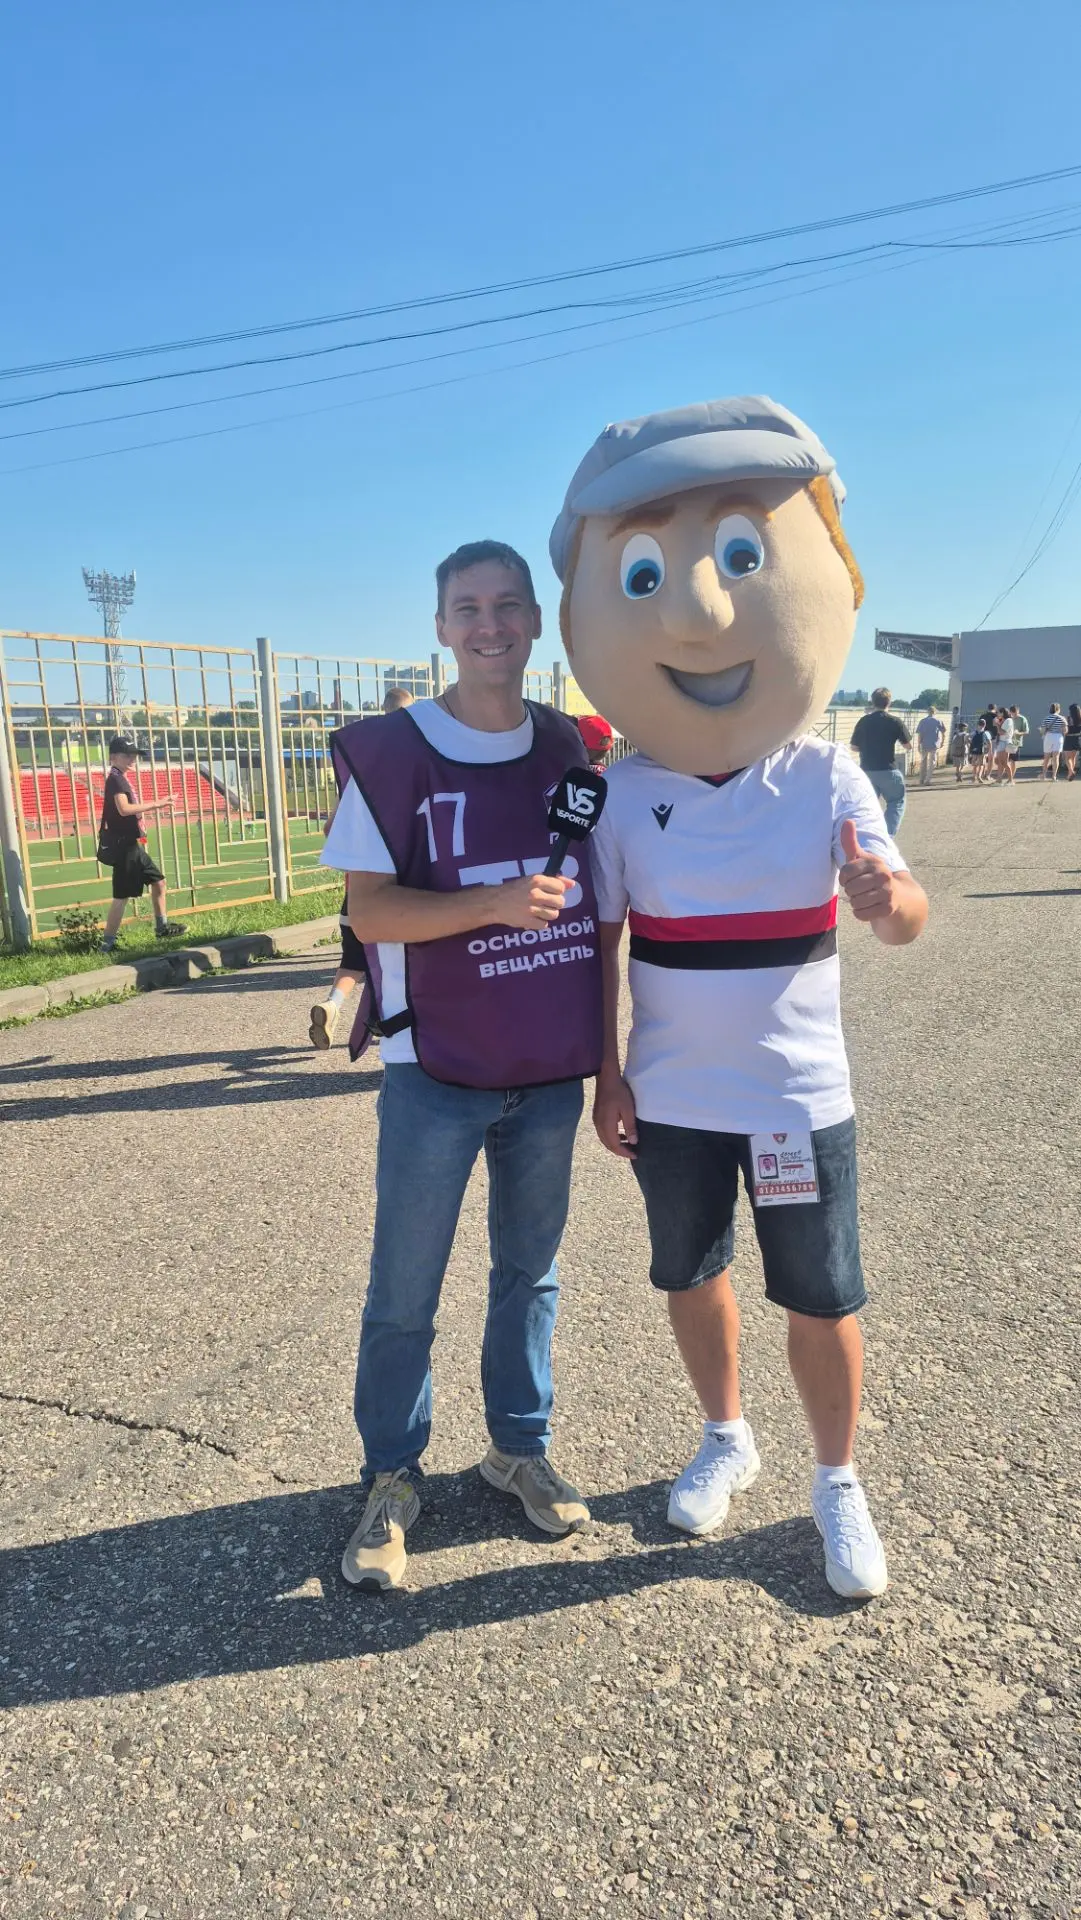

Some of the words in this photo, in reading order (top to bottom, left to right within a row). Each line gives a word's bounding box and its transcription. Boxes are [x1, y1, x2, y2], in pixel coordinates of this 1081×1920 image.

[416, 791, 466, 863] 17
[467, 916, 595, 955] ОСНОВНОЙ
[479, 945, 595, 979] ВЕЩАТЕЛЬ
